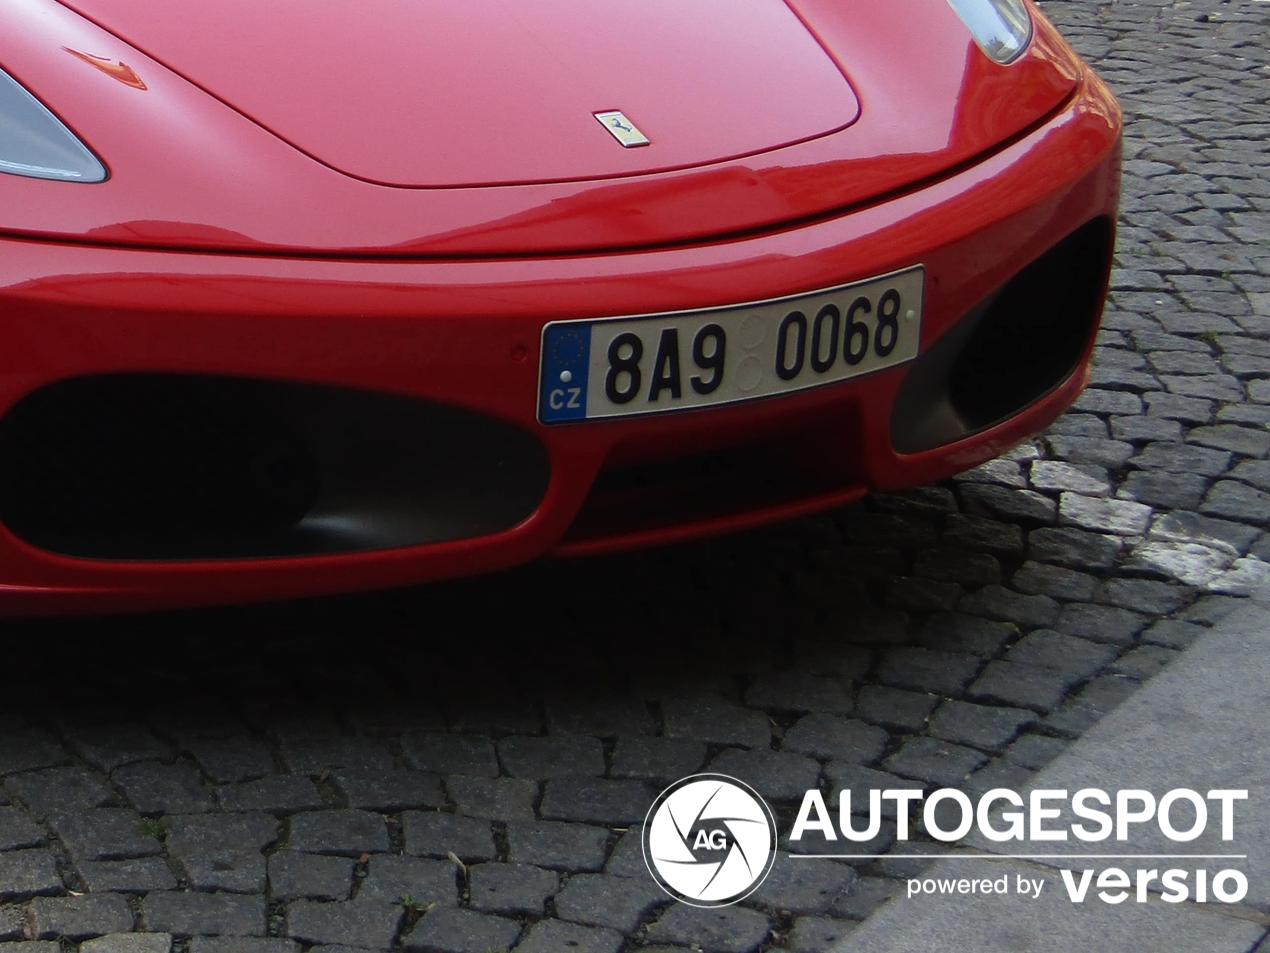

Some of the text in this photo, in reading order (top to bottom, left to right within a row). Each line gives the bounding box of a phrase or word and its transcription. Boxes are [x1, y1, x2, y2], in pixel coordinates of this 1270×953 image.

[604, 288, 902, 406] 8A9 0068
[549, 387, 581, 410] CZ
